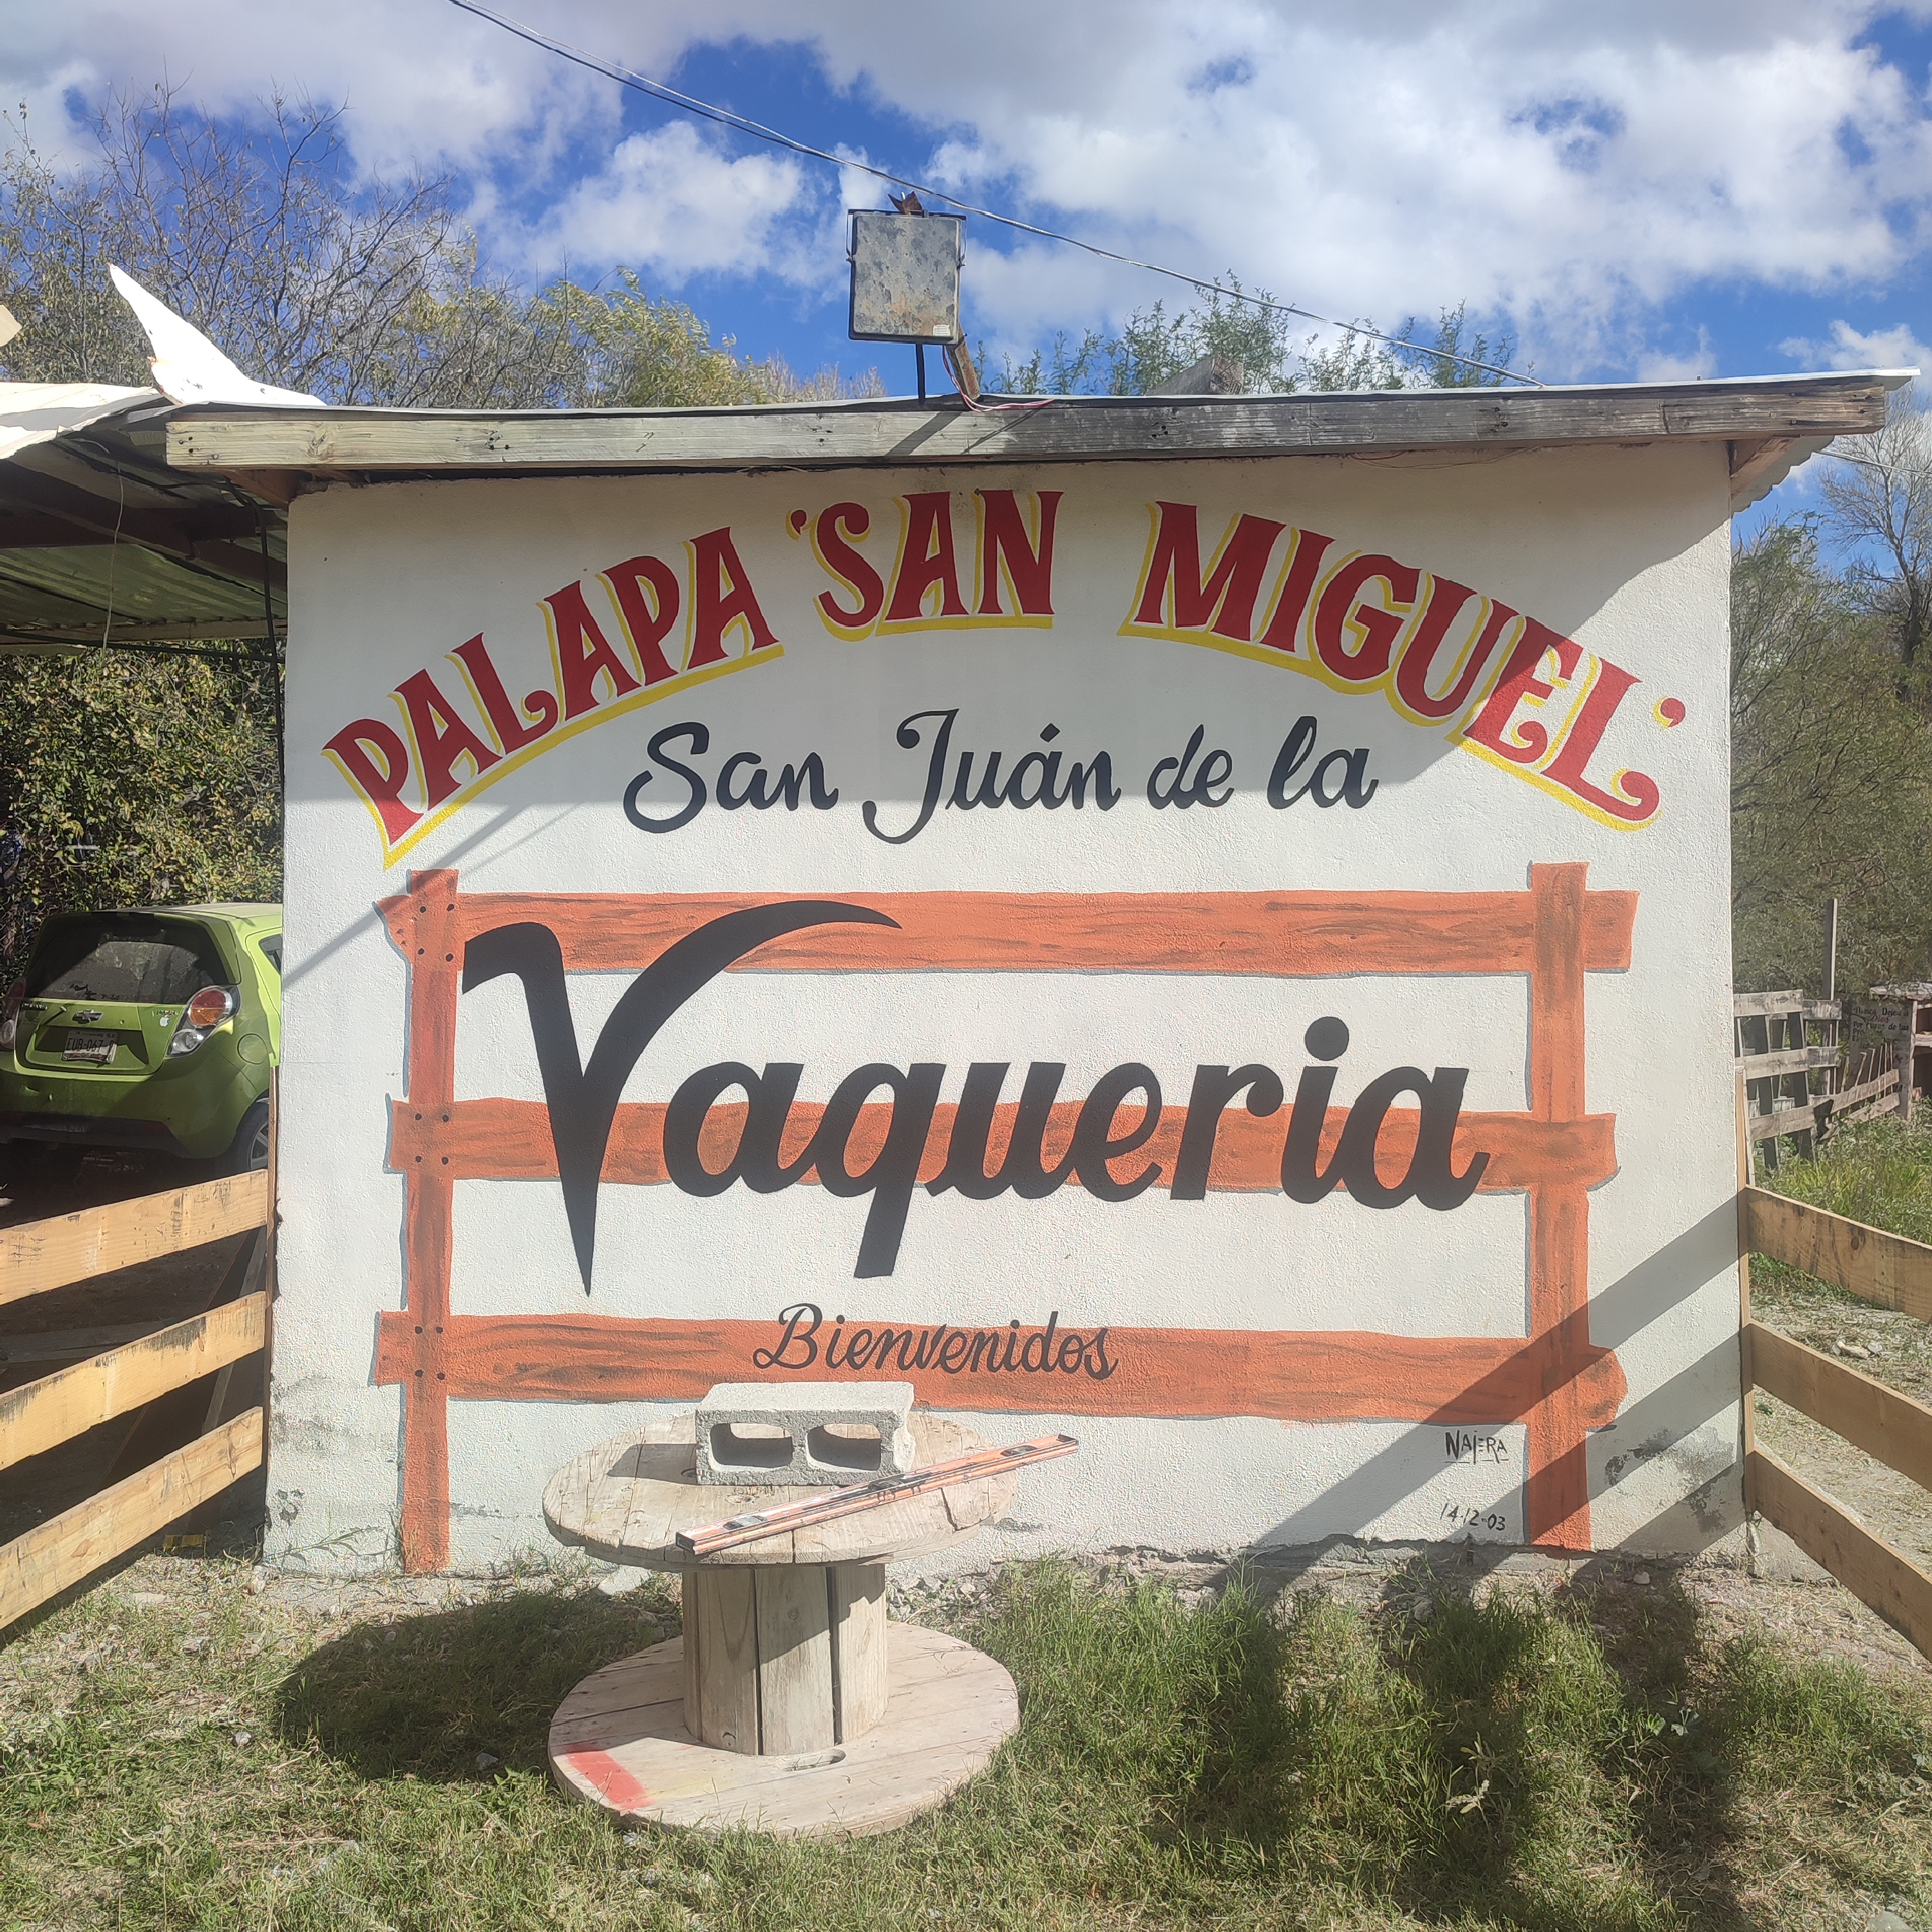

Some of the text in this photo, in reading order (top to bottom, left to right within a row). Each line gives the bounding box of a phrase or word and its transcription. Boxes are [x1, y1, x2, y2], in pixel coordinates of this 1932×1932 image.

[322, 526, 781, 846] PALAPA
[623, 721, 839, 833] San
[1147, 723, 1235, 810] de
[1267, 715, 1379, 810] la
[462, 900, 1491, 1298] Vaqueria
[752, 1302, 1119, 1381] Bienvenidos
